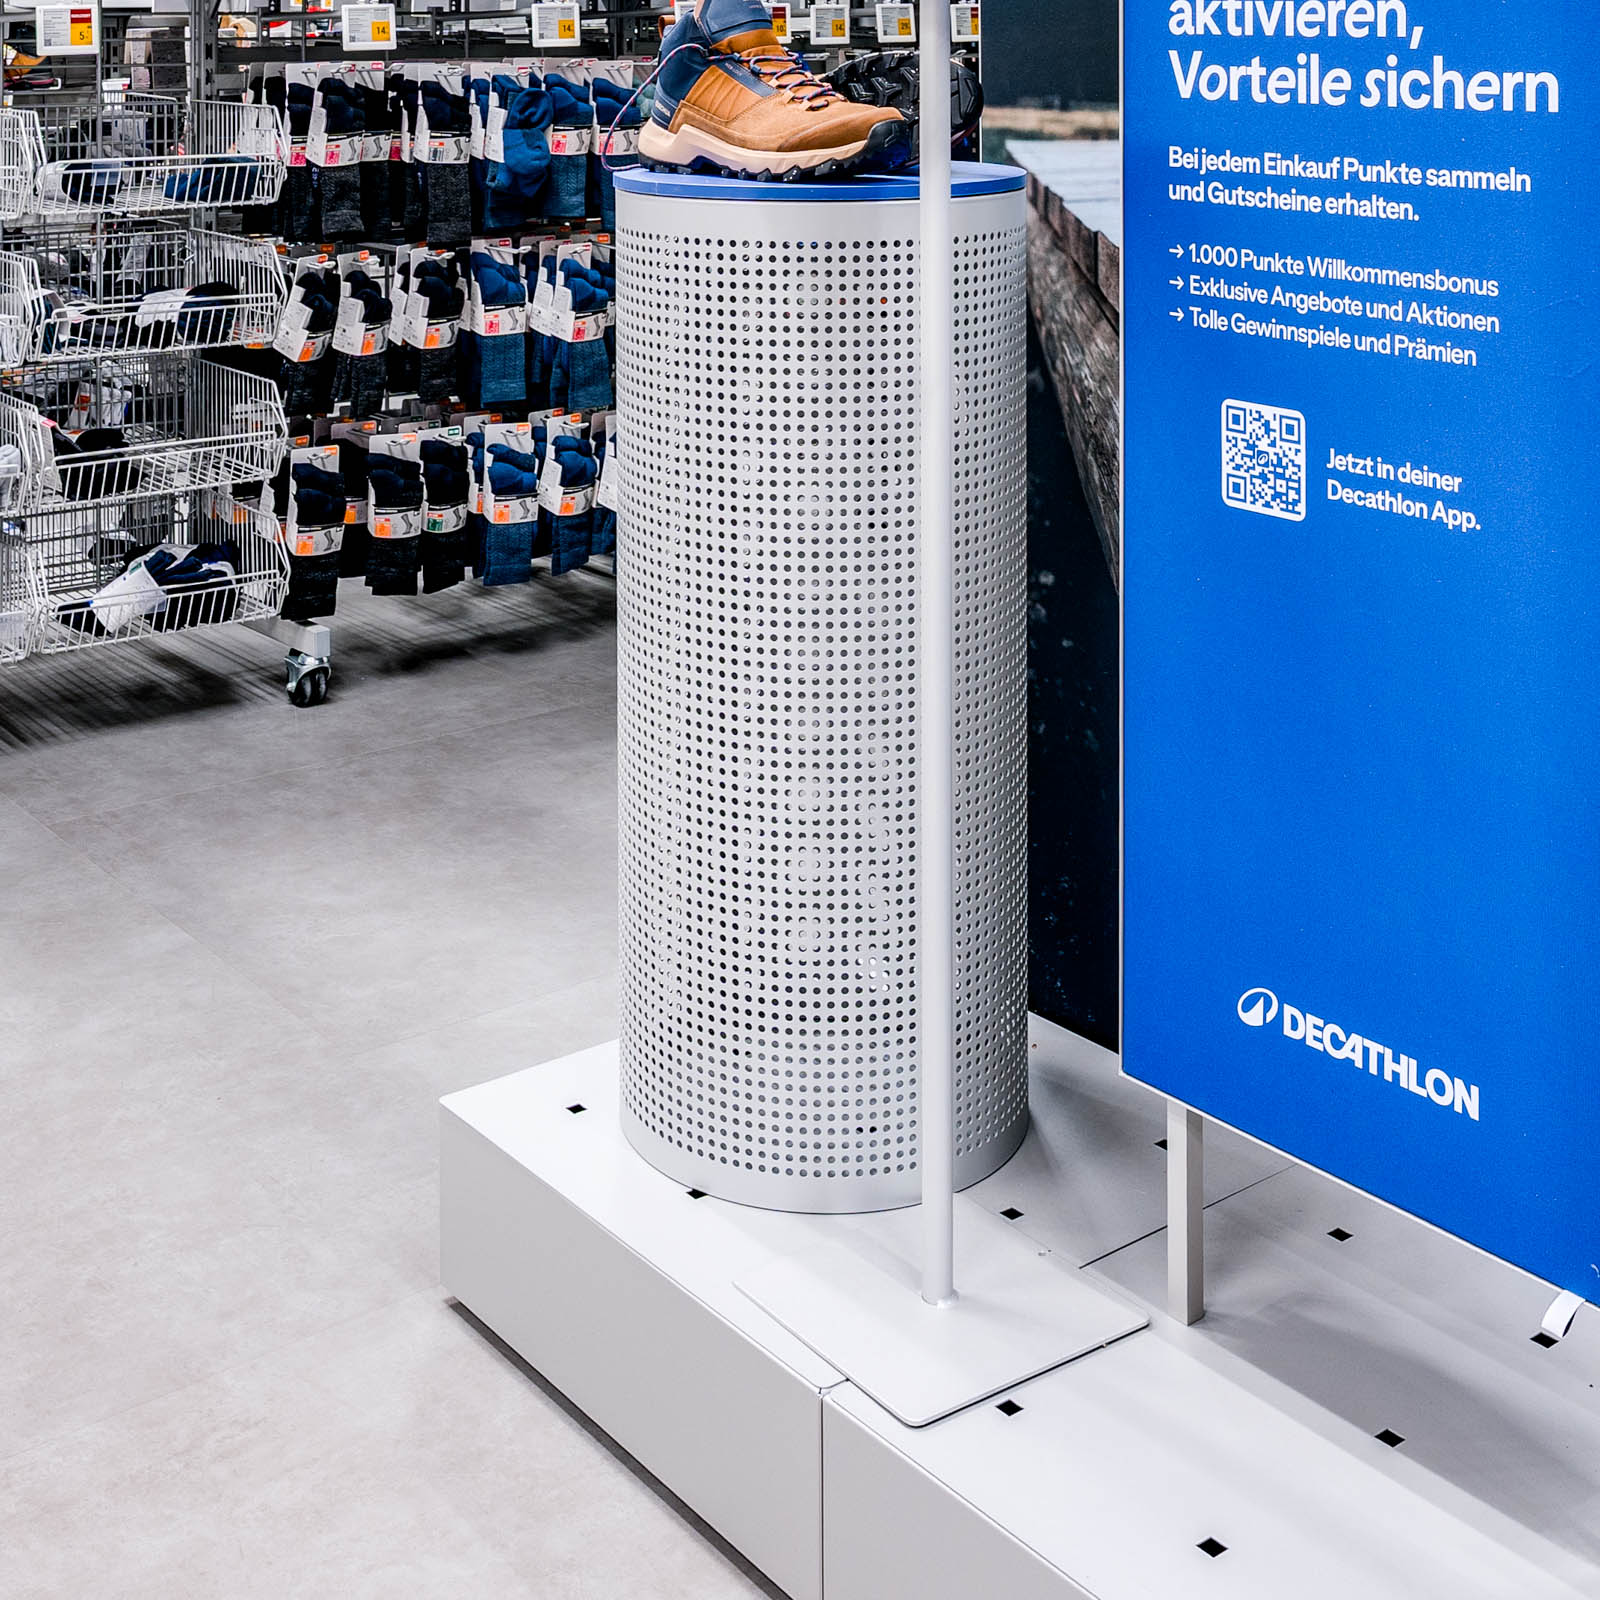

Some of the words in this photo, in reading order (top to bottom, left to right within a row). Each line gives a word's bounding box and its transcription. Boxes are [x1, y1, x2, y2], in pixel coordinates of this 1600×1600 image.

[80, 32, 86, 40] 5
[376, 26, 386, 34] 14
[563, 24, 571, 32] 14
[1168, 50, 1351, 106] Vorteile
[1360, 55, 1558, 112] sichern
[1169, 146, 1198, 169] Bei
[1200, 148, 1260, 174] jedem
[1264, 152, 1340, 179] Einkauf
[1344, 158, 1422, 185] Punkte
[1426, 167, 1531, 192] sammeln
[1169, 181, 1204, 202] und
[1208, 182, 1322, 212] Gutscheine
[1325, 193, 1419, 221] erhalten.
[1189, 244, 1238, 267] 1.000
[1241, 249, 1304, 275] Punkte
[1307, 256, 1498, 296] Willkommensbonus
[1190, 275, 1268, 304] Exklusive
[1270, 285, 1363, 317] Angebote
[1366, 300, 1402, 321] und
[1406, 302, 1499, 333] Aktionen
[1189, 307, 1228, 331] Tolle
[1231, 313, 1351, 348] Gewinnspiele
[1355, 334, 1390, 354] und
[1395, 335, 1476, 366] Prämien
[1327, 448, 1374, 476] Jetzt
[1377, 457, 1394, 480] in
[1397, 462, 1462, 492] deiner
[1328, 479, 1428, 519] Decathlon
[1431, 501, 1481, 532] App.
[1284, 1004, 1479, 1120] DECATHLON
